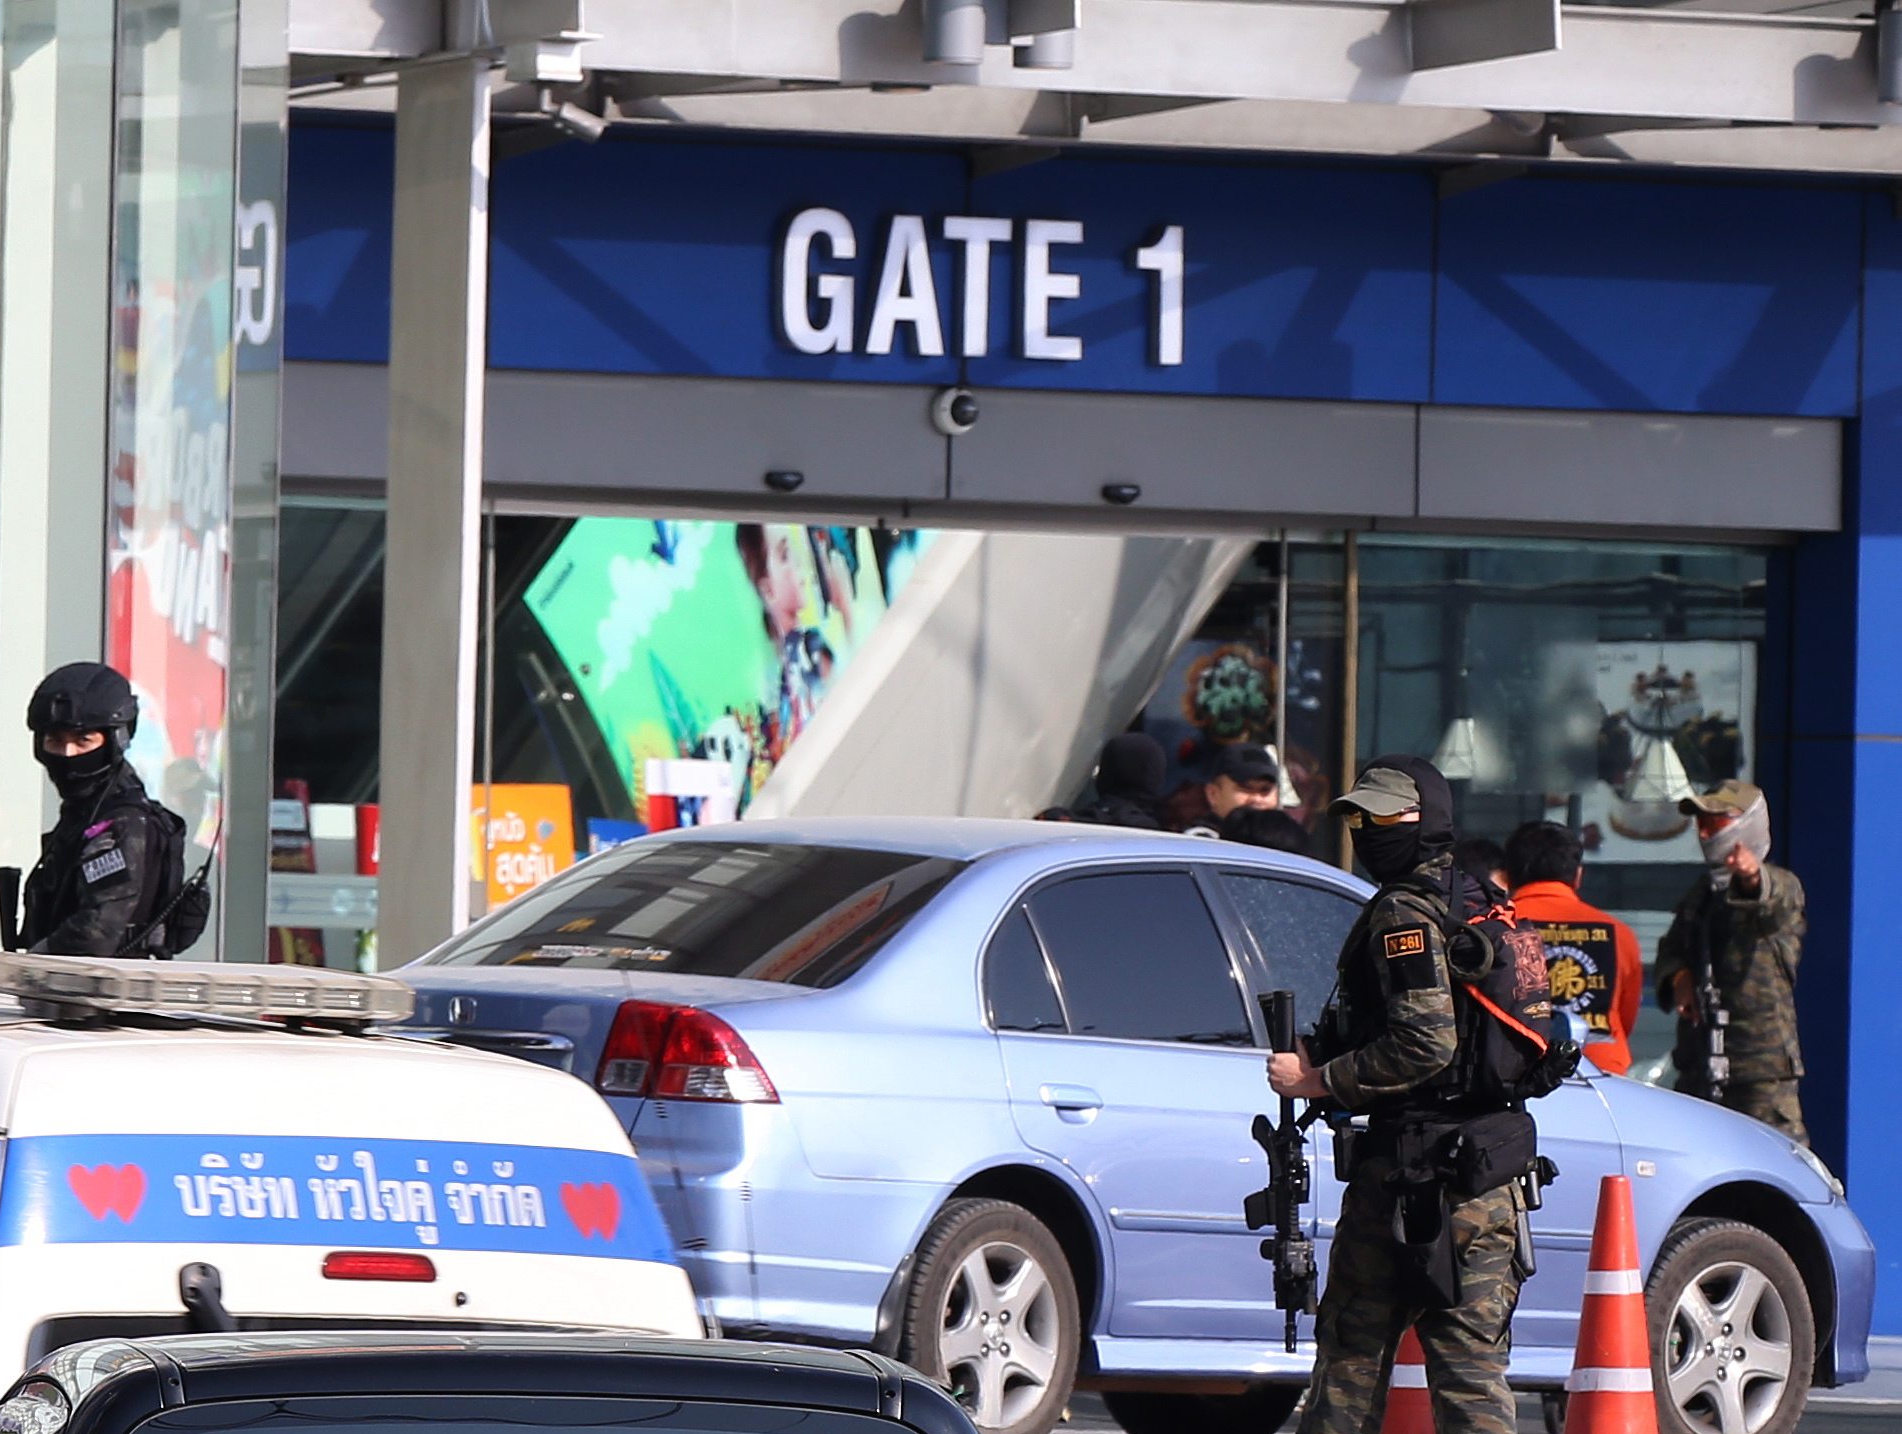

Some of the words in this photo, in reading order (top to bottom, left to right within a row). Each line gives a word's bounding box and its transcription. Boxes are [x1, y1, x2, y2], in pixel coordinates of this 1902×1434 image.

[783, 207, 1084, 361] GATE
[1137, 225, 1184, 366] 1
[173, 1151, 300, 1220] บริษัท
[307, 1150, 440, 1245] หัวใจคู่
[444, 1160, 546, 1228] จำกัด
